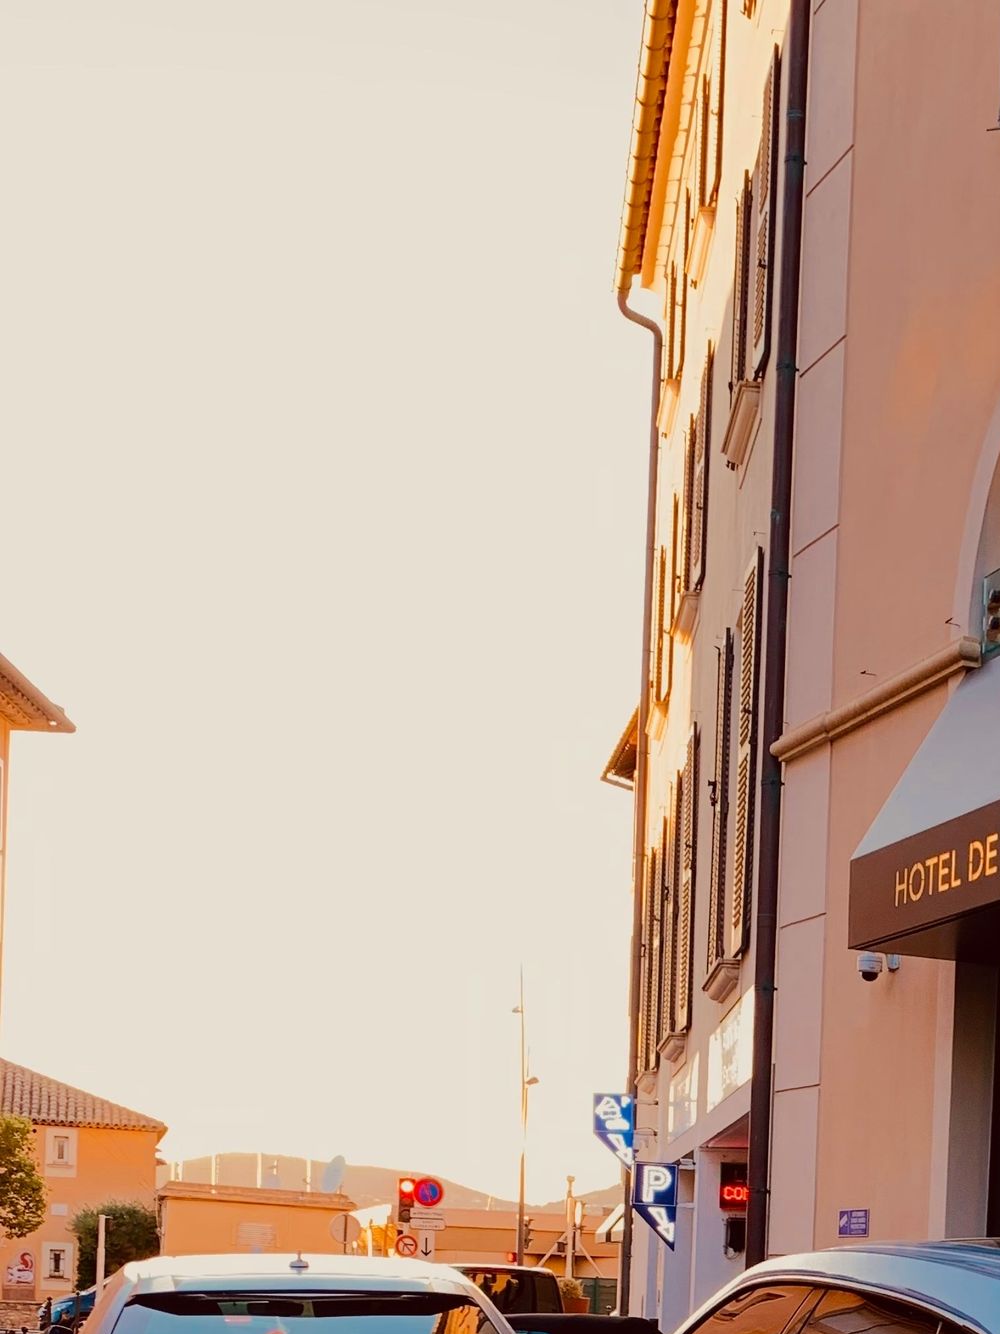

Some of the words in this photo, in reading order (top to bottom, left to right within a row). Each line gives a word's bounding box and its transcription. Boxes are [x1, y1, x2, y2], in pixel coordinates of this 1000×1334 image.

[894, 849, 962, 907] HOTEL
[968, 833, 999, 882] DE
[642, 1165, 672, 1202] P
